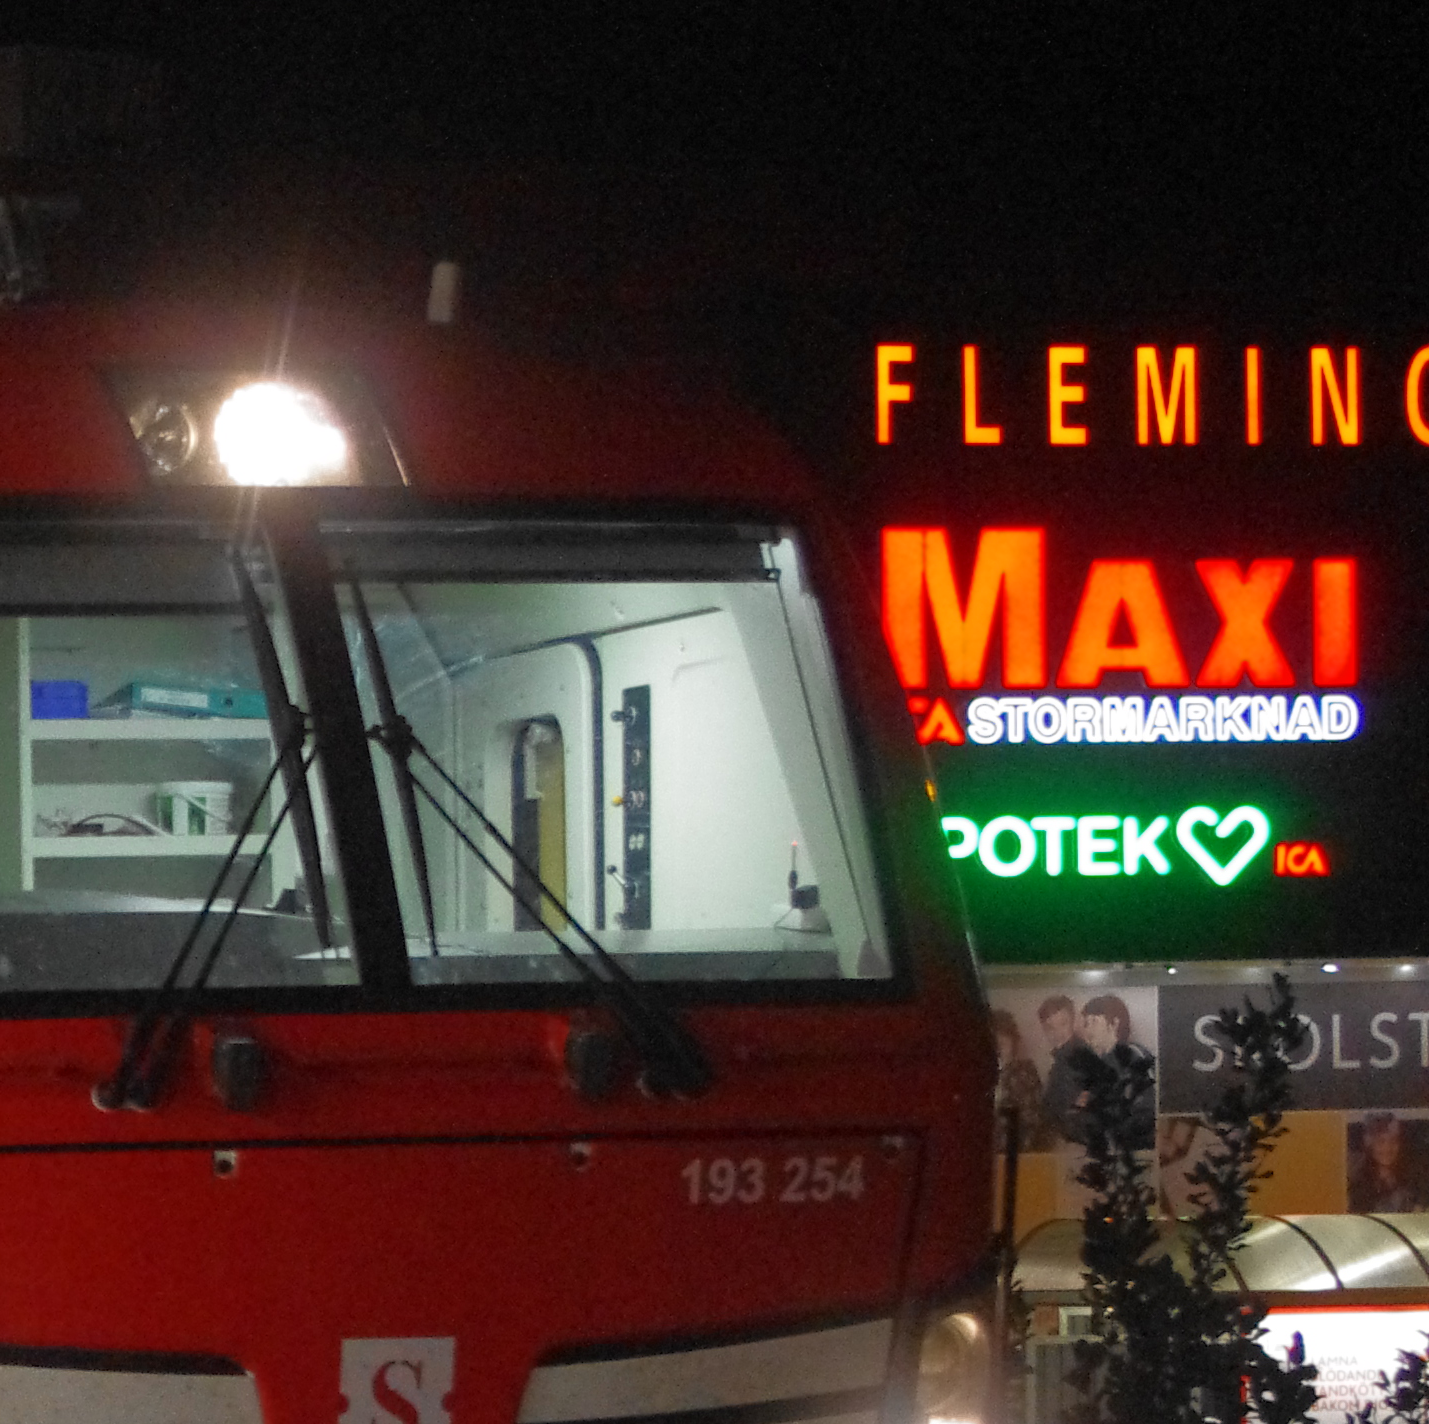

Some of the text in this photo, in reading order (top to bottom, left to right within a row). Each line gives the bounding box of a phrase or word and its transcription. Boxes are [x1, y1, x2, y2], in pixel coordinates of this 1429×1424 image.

[881, 526, 1358, 689] MAXI
[967, 694, 1360, 744] STORMARKNAD
[1275, 841, 1329, 876] ICA
[1192, 1012, 1429, 1072] SOLST
[681, 1156, 866, 1205] 193 254
